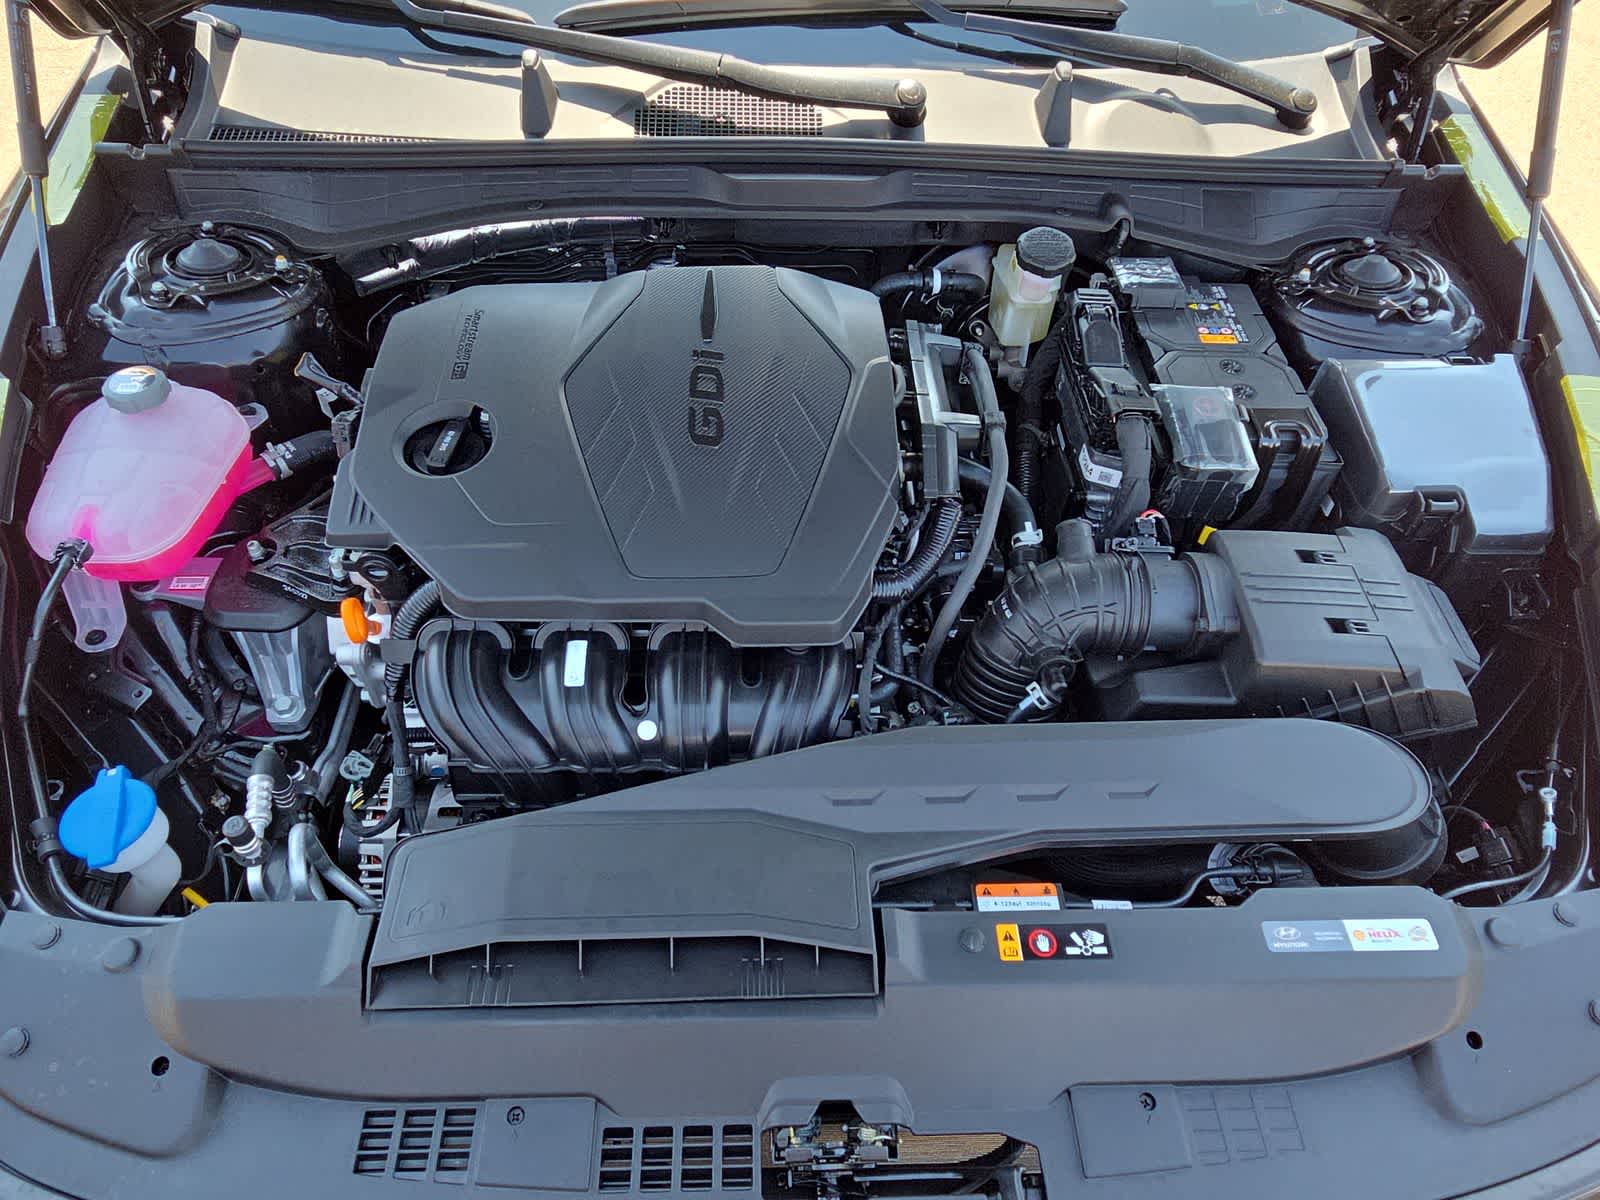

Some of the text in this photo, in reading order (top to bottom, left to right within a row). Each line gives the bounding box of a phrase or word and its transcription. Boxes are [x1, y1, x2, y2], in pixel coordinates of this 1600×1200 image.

[464, 308, 485, 361] Smartstream
[688, 349, 724, 447] GDi
[1367, 928, 1401, 939] HELIX
